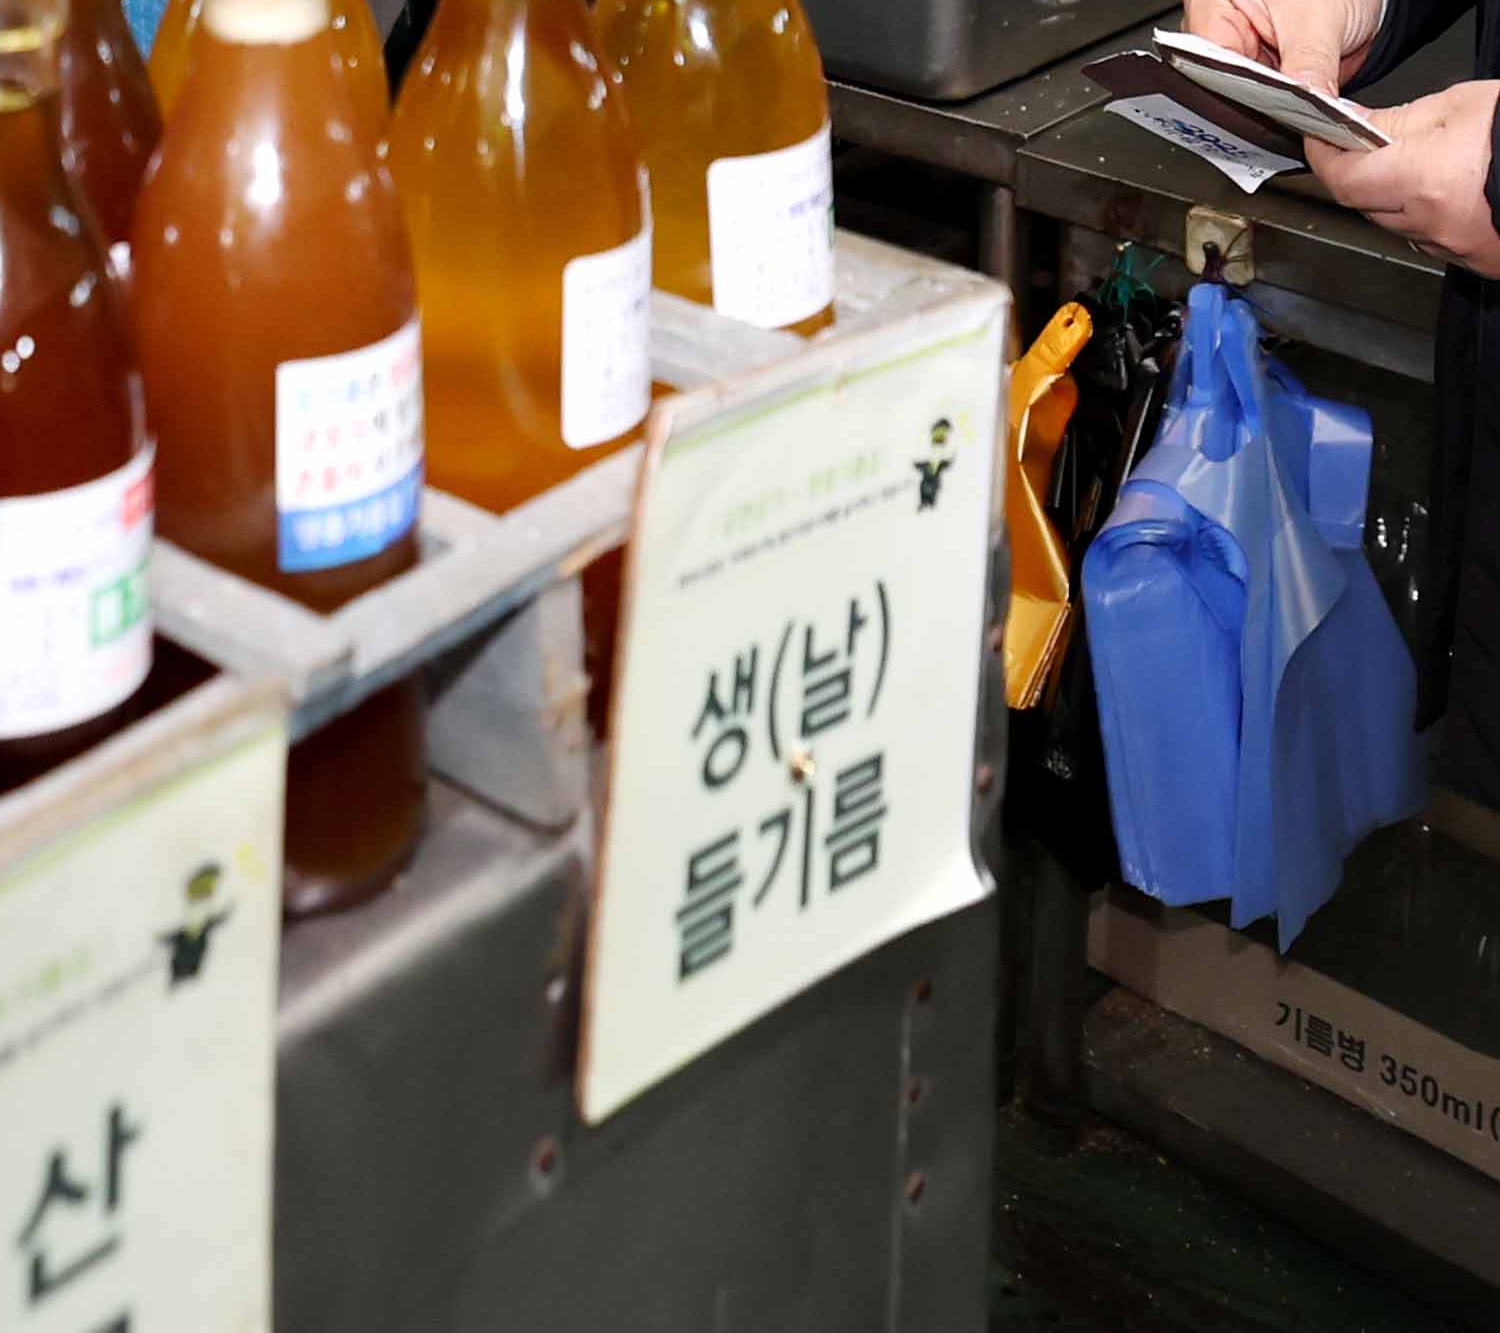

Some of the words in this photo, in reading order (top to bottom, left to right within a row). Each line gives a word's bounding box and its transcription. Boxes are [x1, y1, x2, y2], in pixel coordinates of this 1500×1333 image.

[691, 579, 891, 792] 생(날)
[675, 750, 889, 985] 들기름
[1275, 1002, 1366, 1074] 기름병
